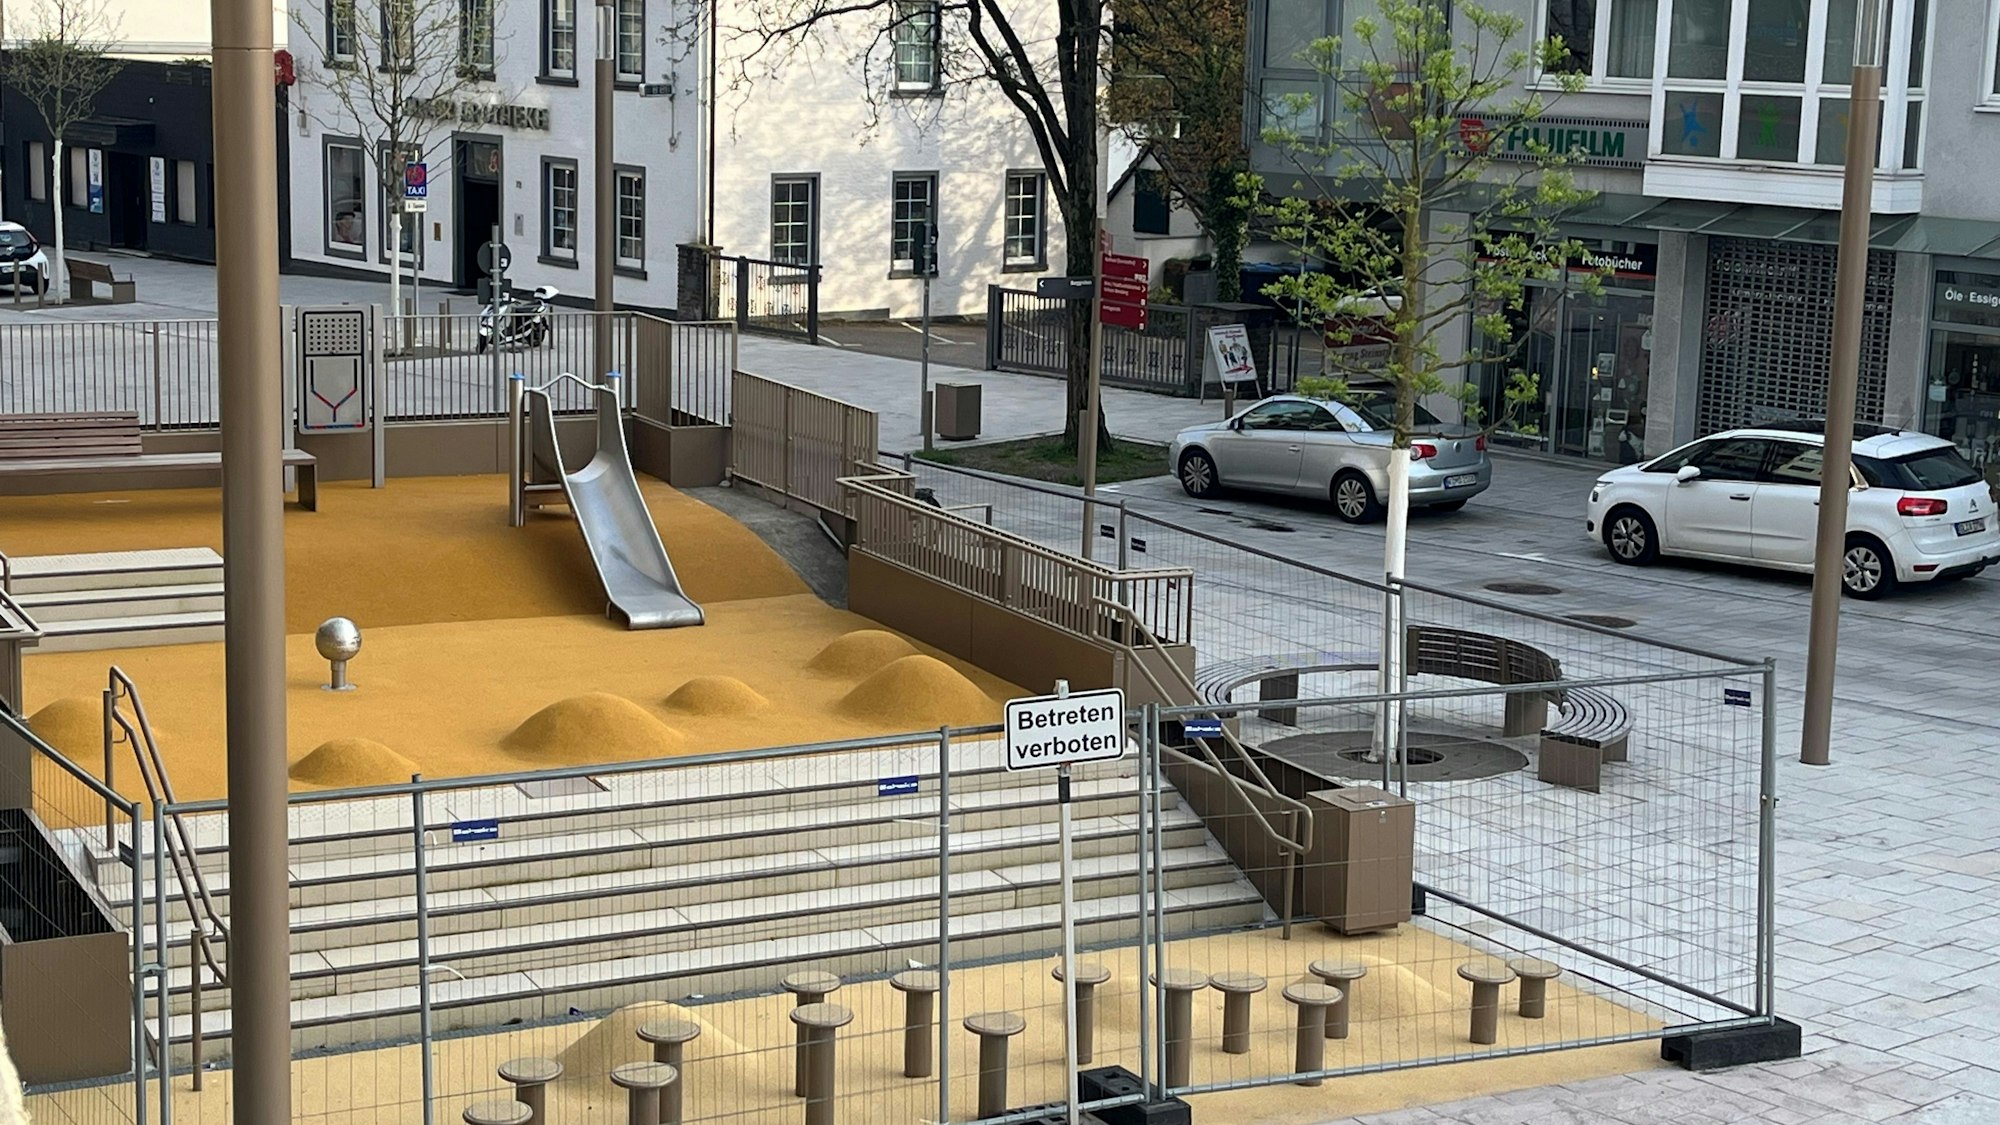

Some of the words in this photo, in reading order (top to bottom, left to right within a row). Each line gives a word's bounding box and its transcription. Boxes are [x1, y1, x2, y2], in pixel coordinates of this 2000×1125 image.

[1507, 126, 1625, 158] FUJIFILM
[407, 186, 426, 195] TAXI
[1582, 255, 1643, 271] Fotobücher
[1945, 287, 1964, 301] Öle
[1969, 291, 2000, 307] Essig
[1018, 705, 1114, 731] Betreten
[1015, 734, 1117, 759] verboten
